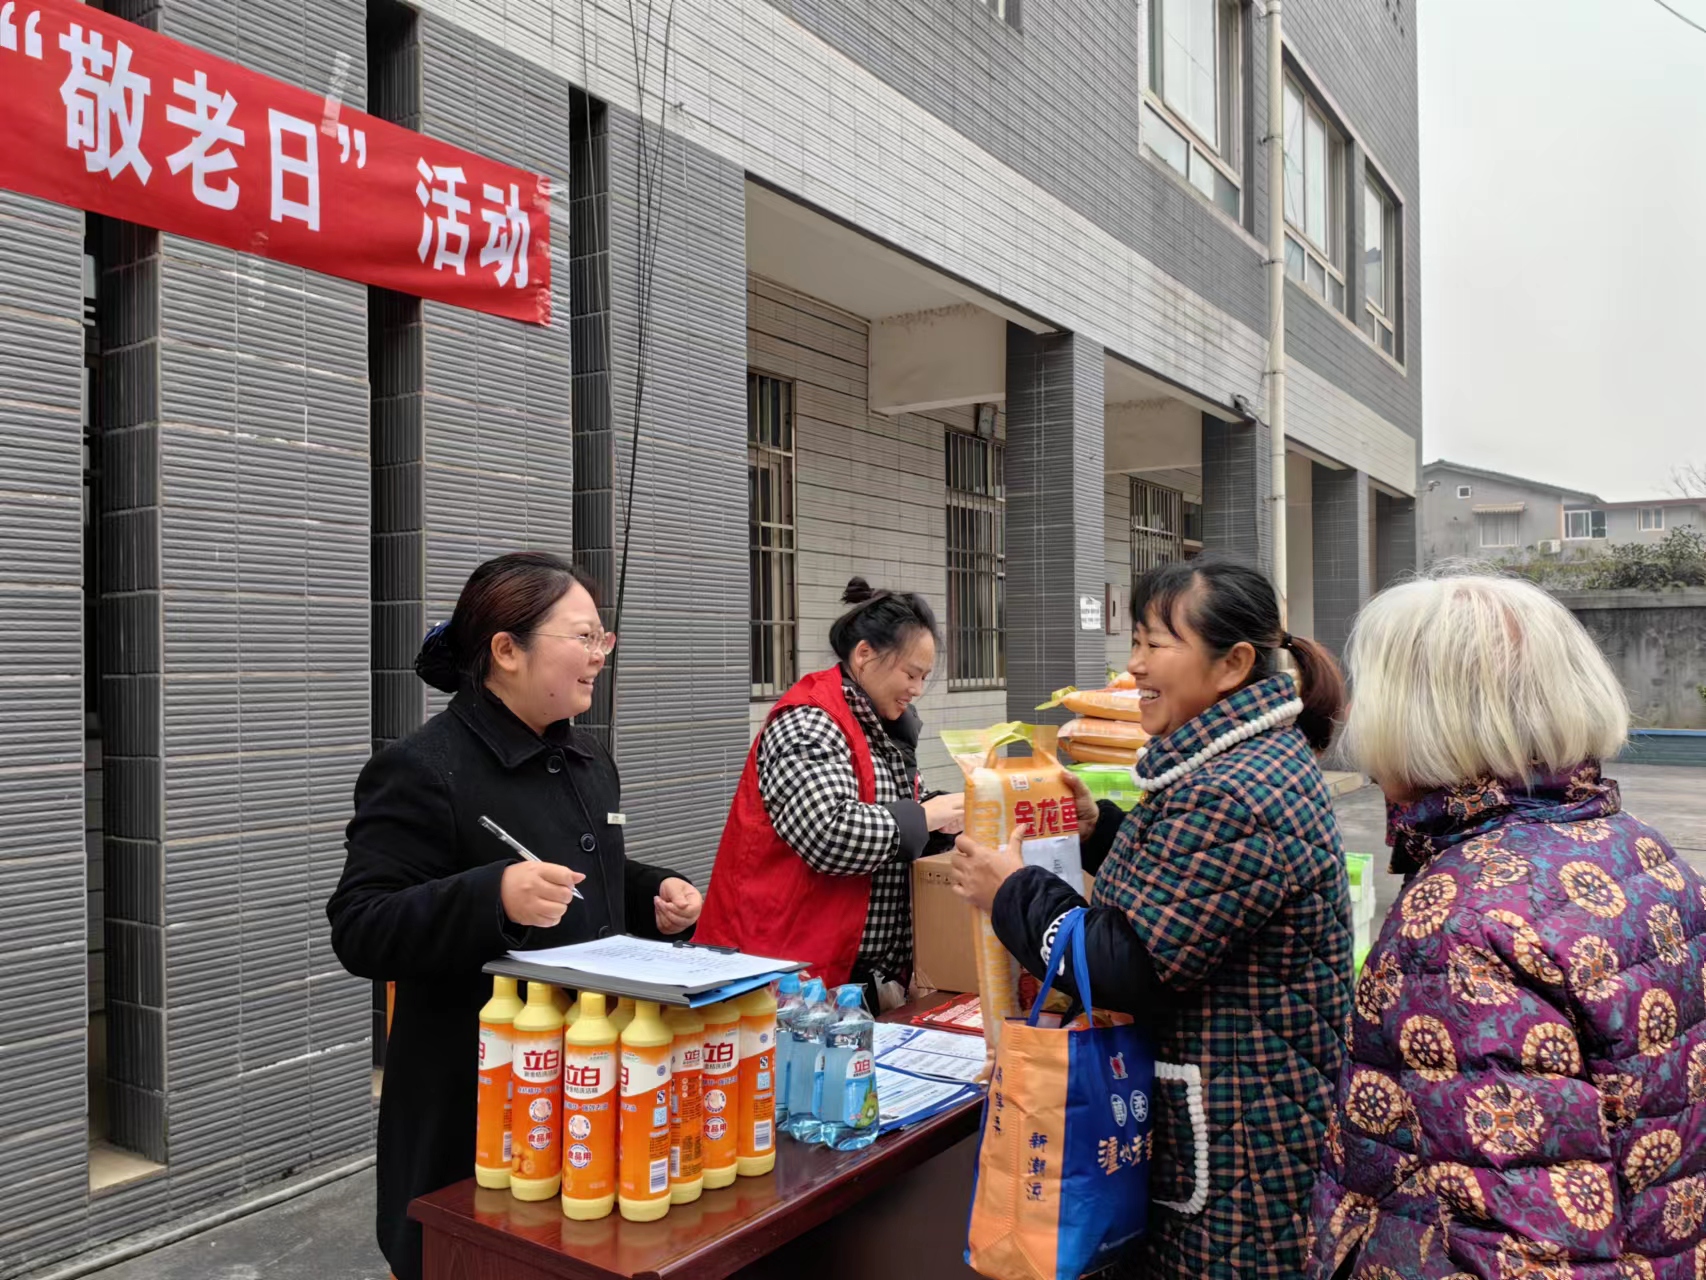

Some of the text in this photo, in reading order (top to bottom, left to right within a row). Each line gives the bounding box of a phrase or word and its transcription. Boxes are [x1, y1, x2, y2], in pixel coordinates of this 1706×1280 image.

[1014, 796, 1079, 837] 金龙鱼
[523, 1049, 559, 1070] 立白
[703, 1042, 734, 1062] 立白
[565, 1064, 600, 1087] 立白
[854, 1059, 870, 1073] 立白
